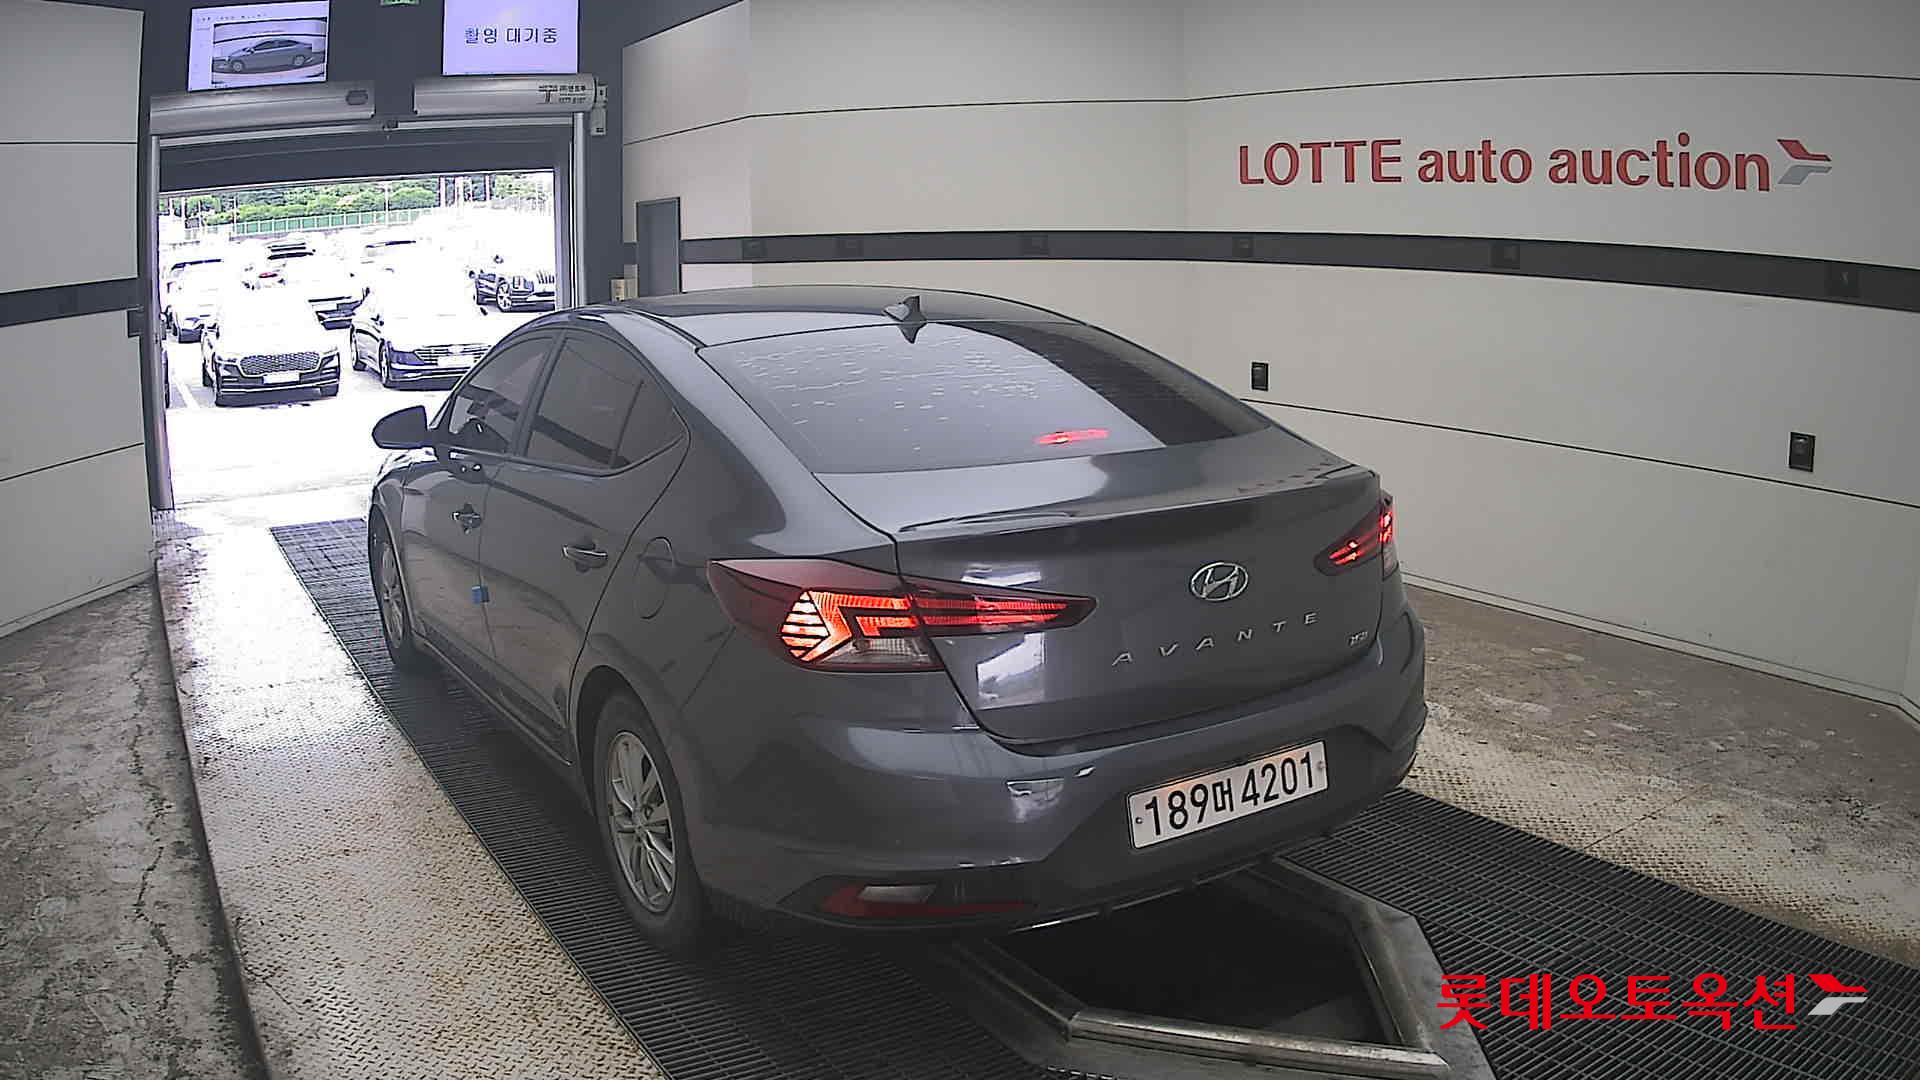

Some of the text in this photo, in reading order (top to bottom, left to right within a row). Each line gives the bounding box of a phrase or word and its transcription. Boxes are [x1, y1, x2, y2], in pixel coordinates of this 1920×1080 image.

[1240, 132, 1771, 192] LOTTE auto auction
[1112, 612, 1318, 667] AVANTE
